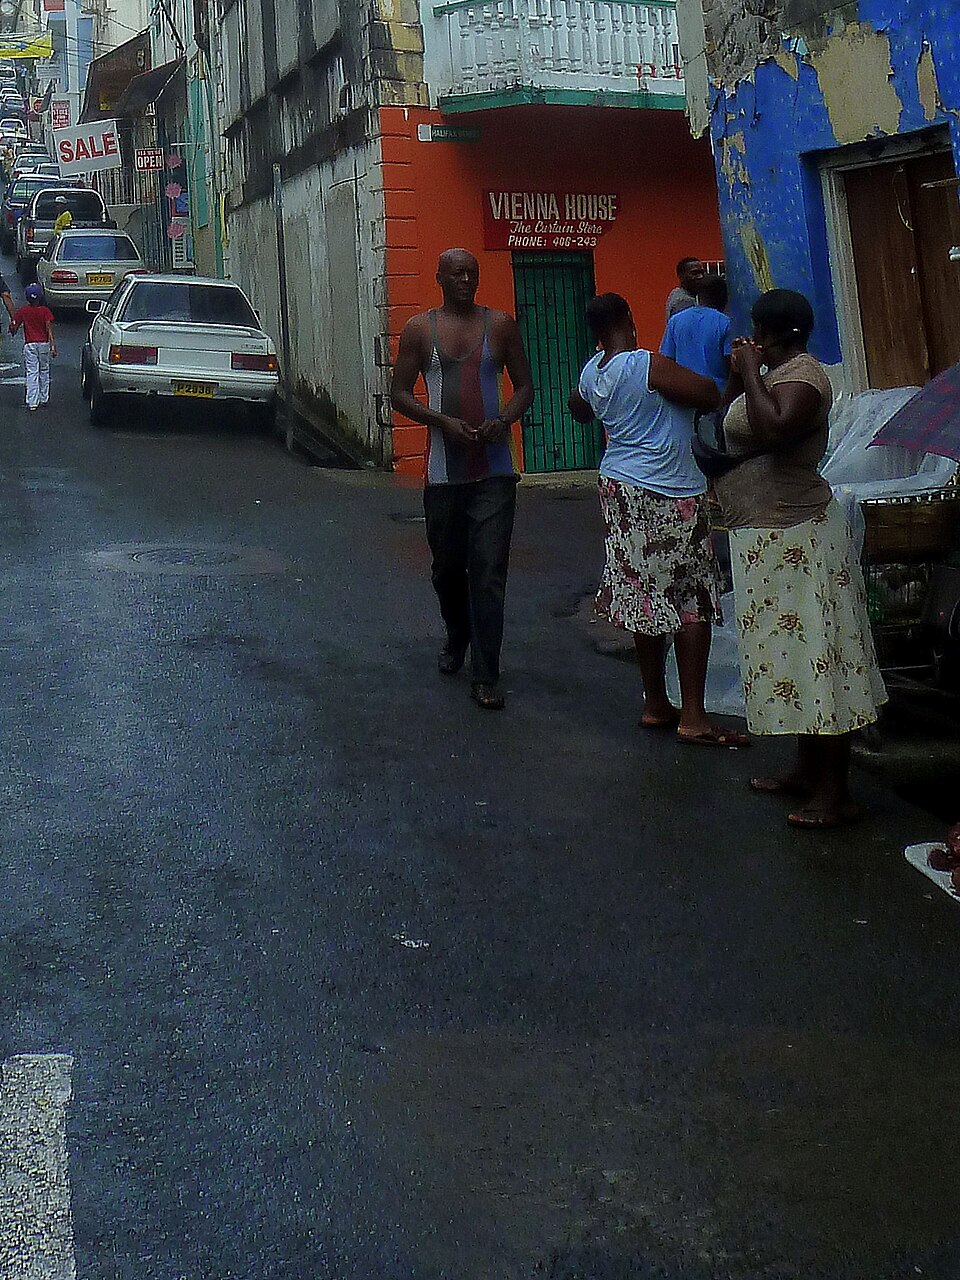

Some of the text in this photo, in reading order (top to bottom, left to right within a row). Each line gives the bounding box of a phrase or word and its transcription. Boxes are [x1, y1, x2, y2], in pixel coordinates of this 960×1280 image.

[59, 132, 118, 163] SALE
[137, 155, 162, 168] OPEN
[489, 192, 617, 221] VIENNA HOUSE
[509, 220, 602, 234] The Curtain Store
[508, 235, 547, 247] PHONE:
